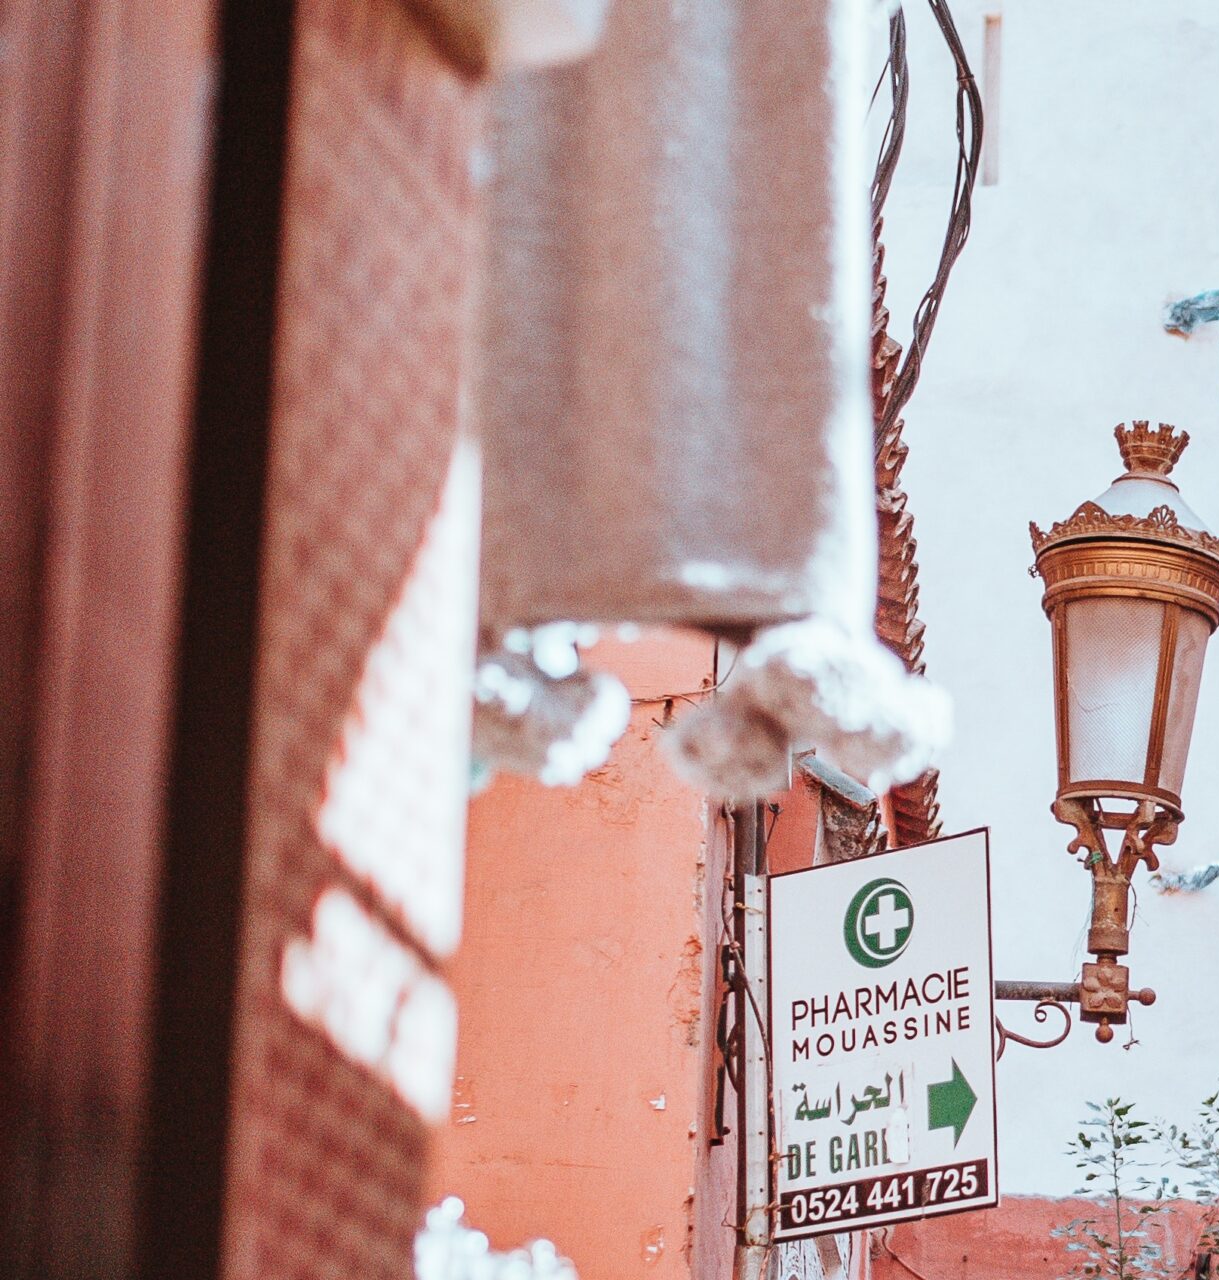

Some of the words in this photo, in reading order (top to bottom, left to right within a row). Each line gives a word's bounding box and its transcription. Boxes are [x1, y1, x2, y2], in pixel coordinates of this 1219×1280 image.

[792, 967, 970, 1031] PHARMACIE
[792, 1006, 970, 1062] MOUASSINE
[792, 1069, 905, 1126] الحراسة
[788, 1140, 817, 1181] DE
[829, 1123, 910, 1174] GAR
[791, 1186, 859, 1224] 0524
[866, 1175, 915, 1210] 441
[926, 1165, 978, 1201] 725
